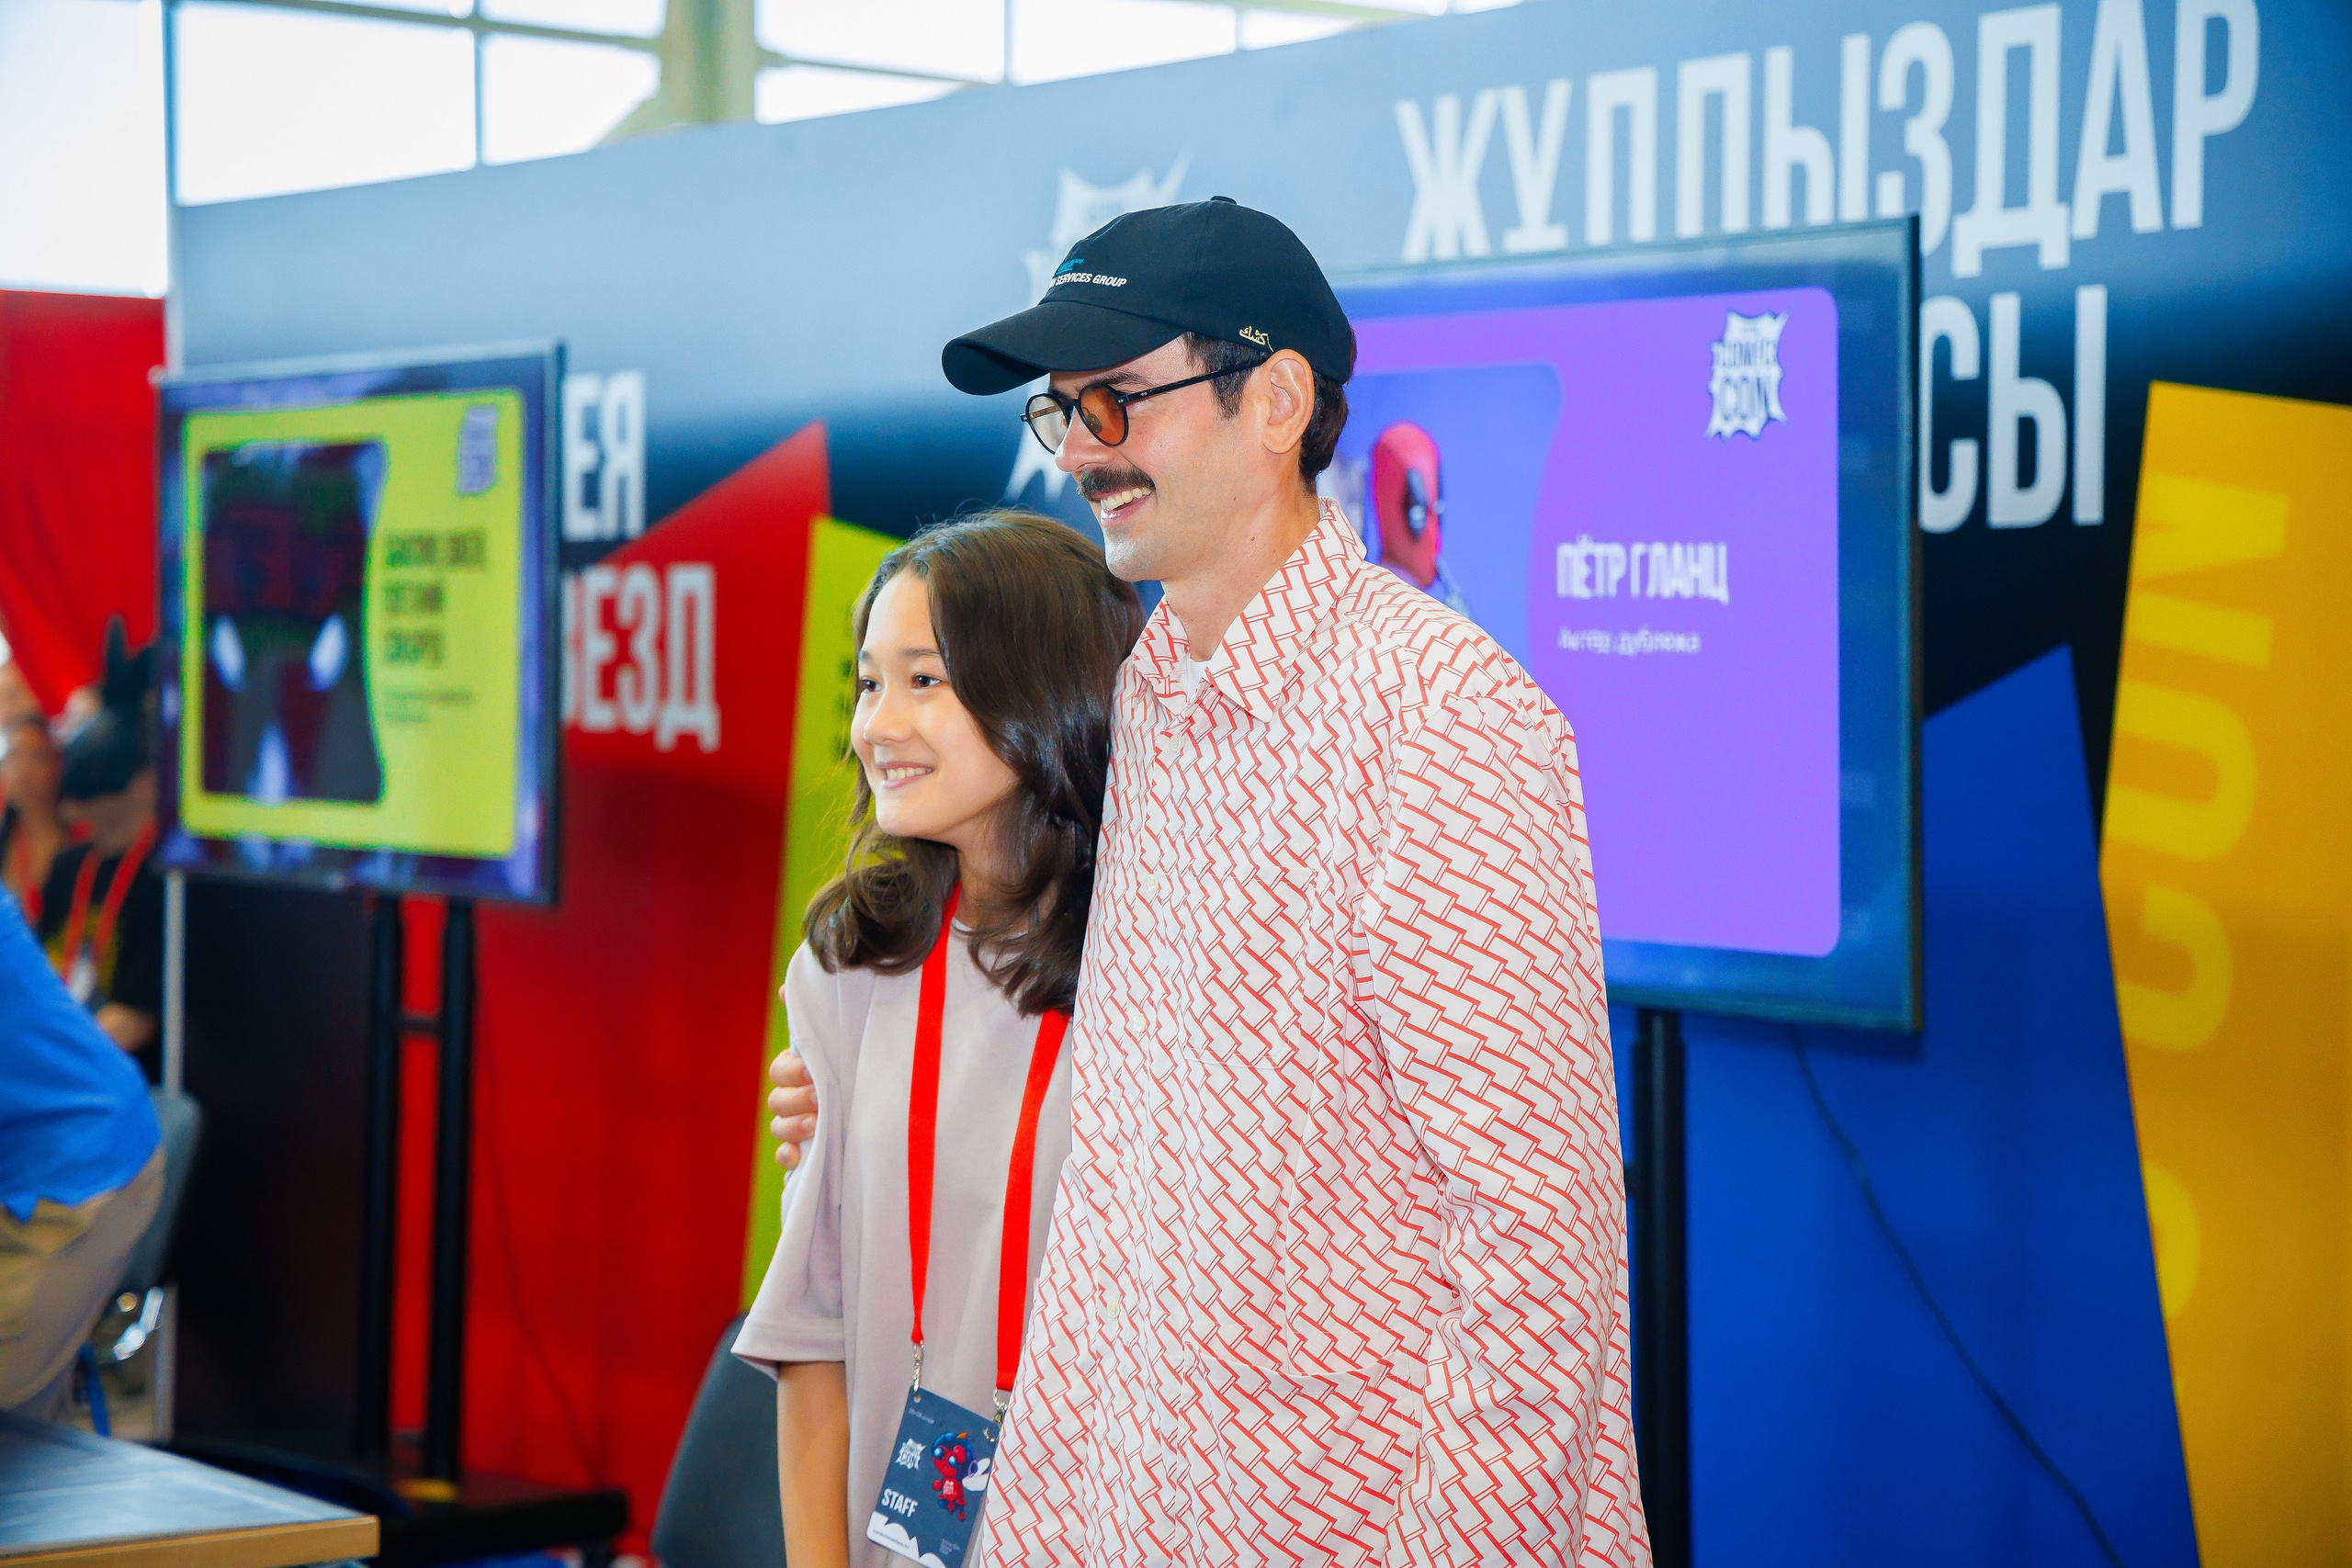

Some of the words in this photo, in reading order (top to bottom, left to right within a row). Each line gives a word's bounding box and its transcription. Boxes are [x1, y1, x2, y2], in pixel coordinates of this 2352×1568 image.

[1055, 272, 1092, 287] SERVICES
[1092, 275, 1127, 288] GROUP
[1718, 375, 1771, 423] CON
[1556, 534, 1627, 598] ПЁТР
[1630, 541, 1730, 606] ГЛАНЦ
[881, 1488, 919, 1517] STAFF
